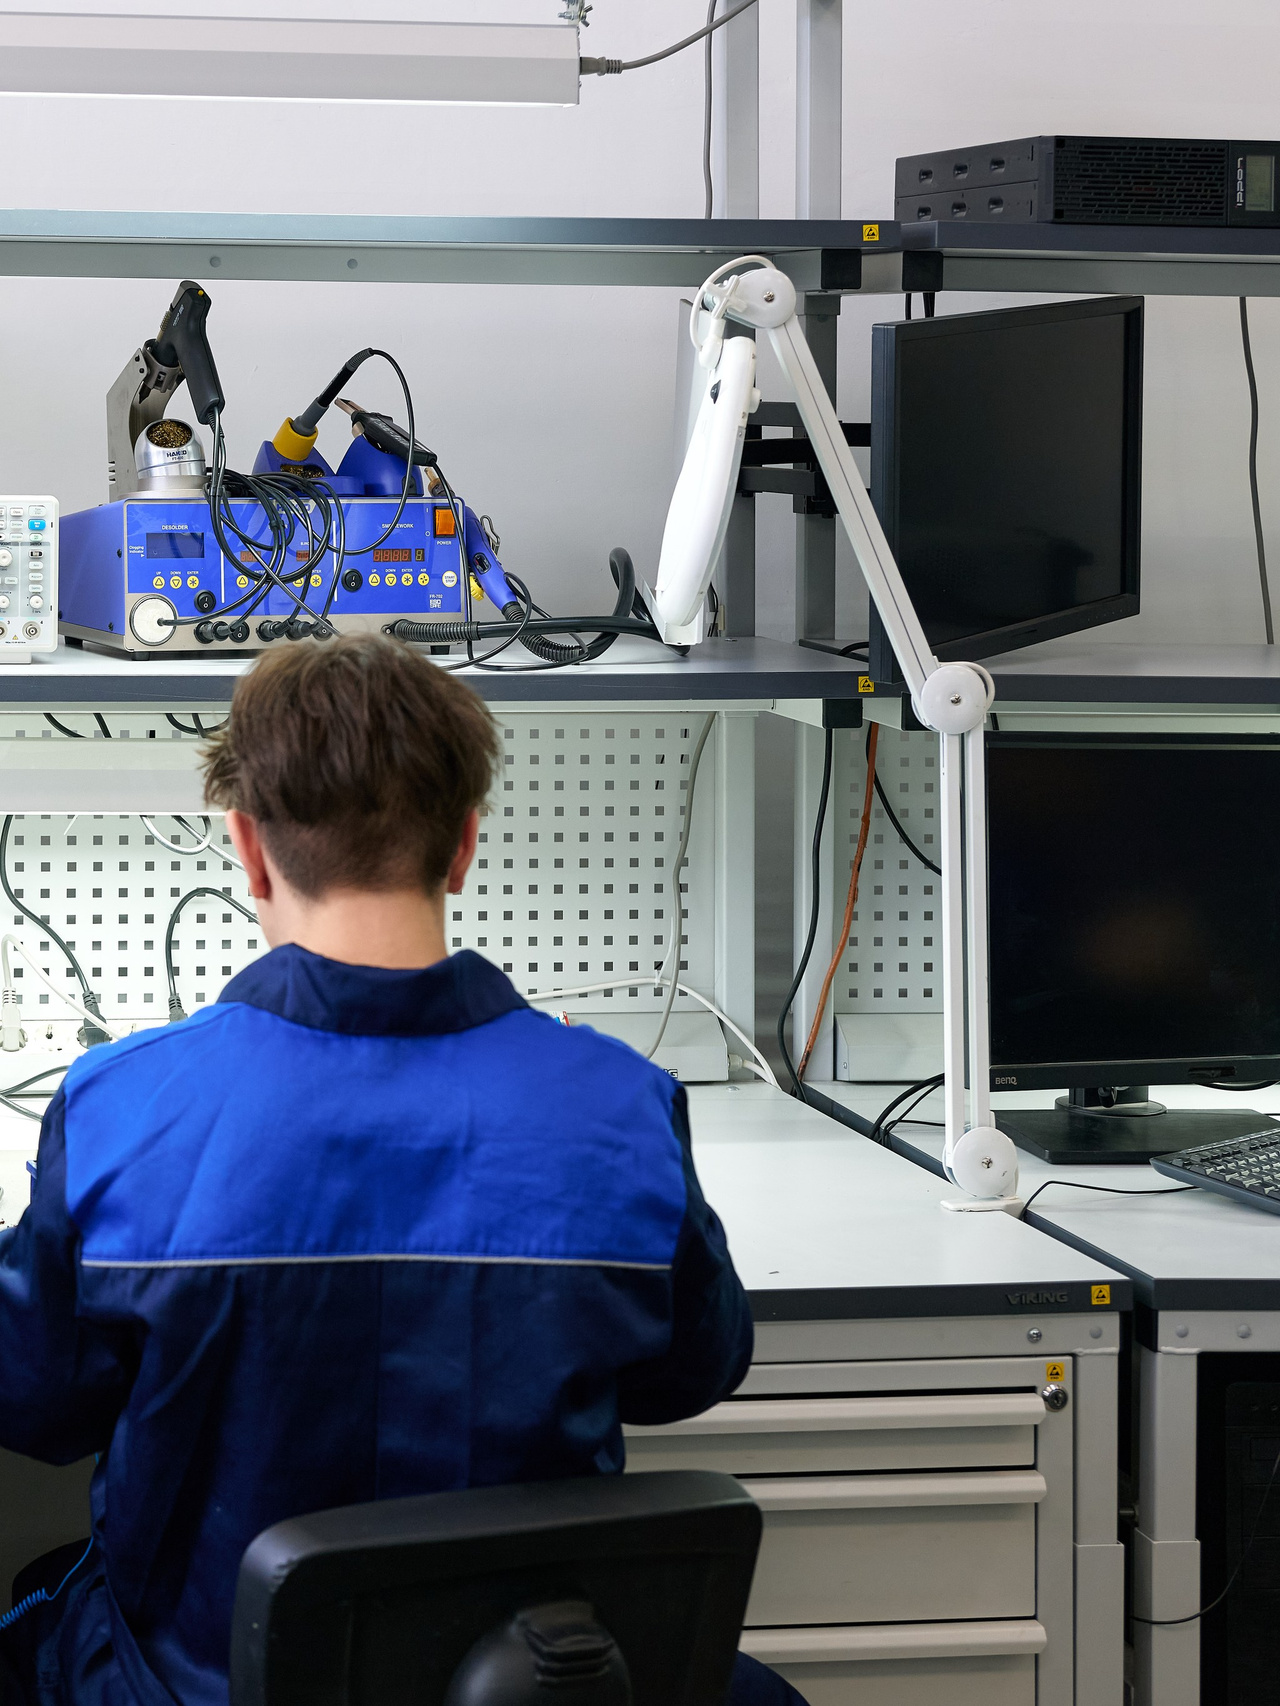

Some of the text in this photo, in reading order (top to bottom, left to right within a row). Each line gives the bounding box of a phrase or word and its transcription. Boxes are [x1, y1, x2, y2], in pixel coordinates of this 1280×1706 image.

[1234, 157, 1244, 208] ippon
[995, 1076, 1018, 1086] BenQ
[1005, 1292, 1069, 1305] VIKING
